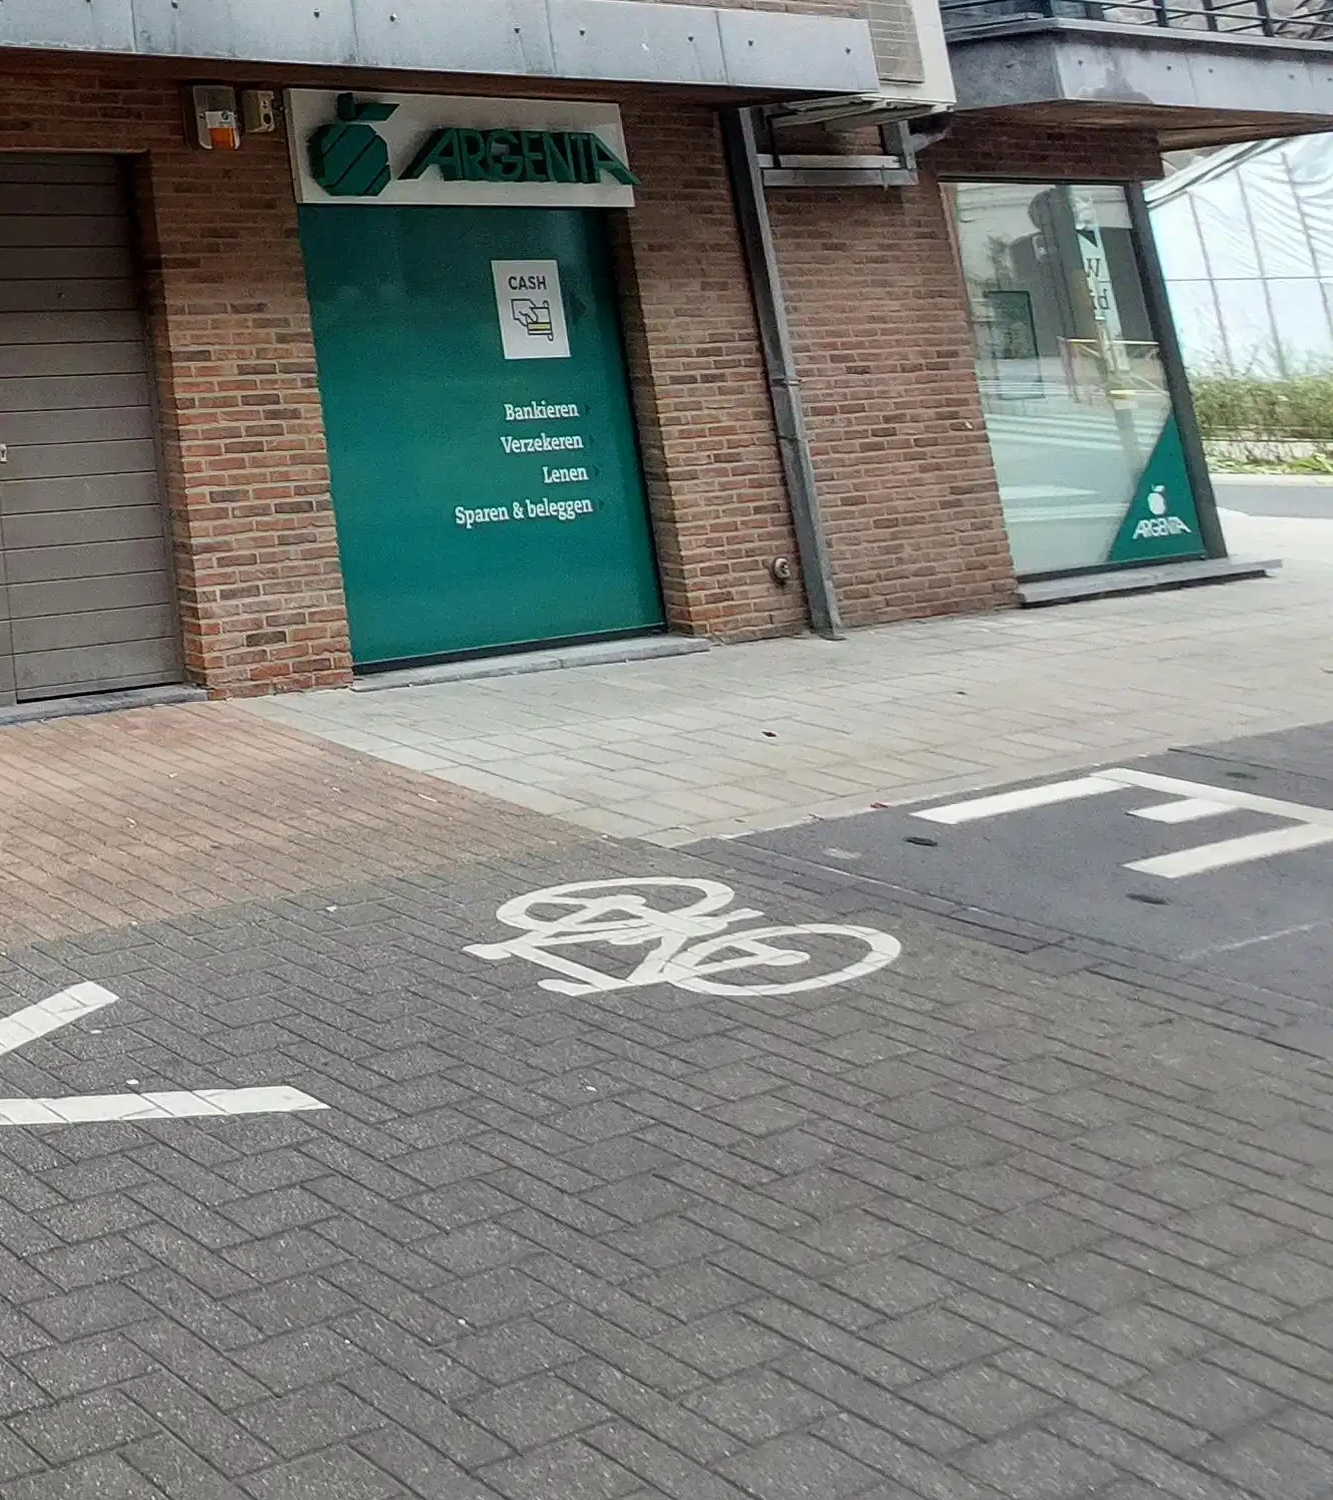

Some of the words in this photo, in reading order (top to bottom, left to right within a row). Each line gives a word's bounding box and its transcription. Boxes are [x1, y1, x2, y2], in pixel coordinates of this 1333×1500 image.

[397, 127, 640, 185] ARGENTA
[508, 276, 547, 290] CASH
[504, 400, 579, 420] Bankieren
[500, 433, 584, 454] Verzekeren
[542, 466, 589, 483] Lenen
[455, 505, 509, 529] Sparen
[513, 501, 525, 519] &
[526, 498, 593, 521] beleggen
